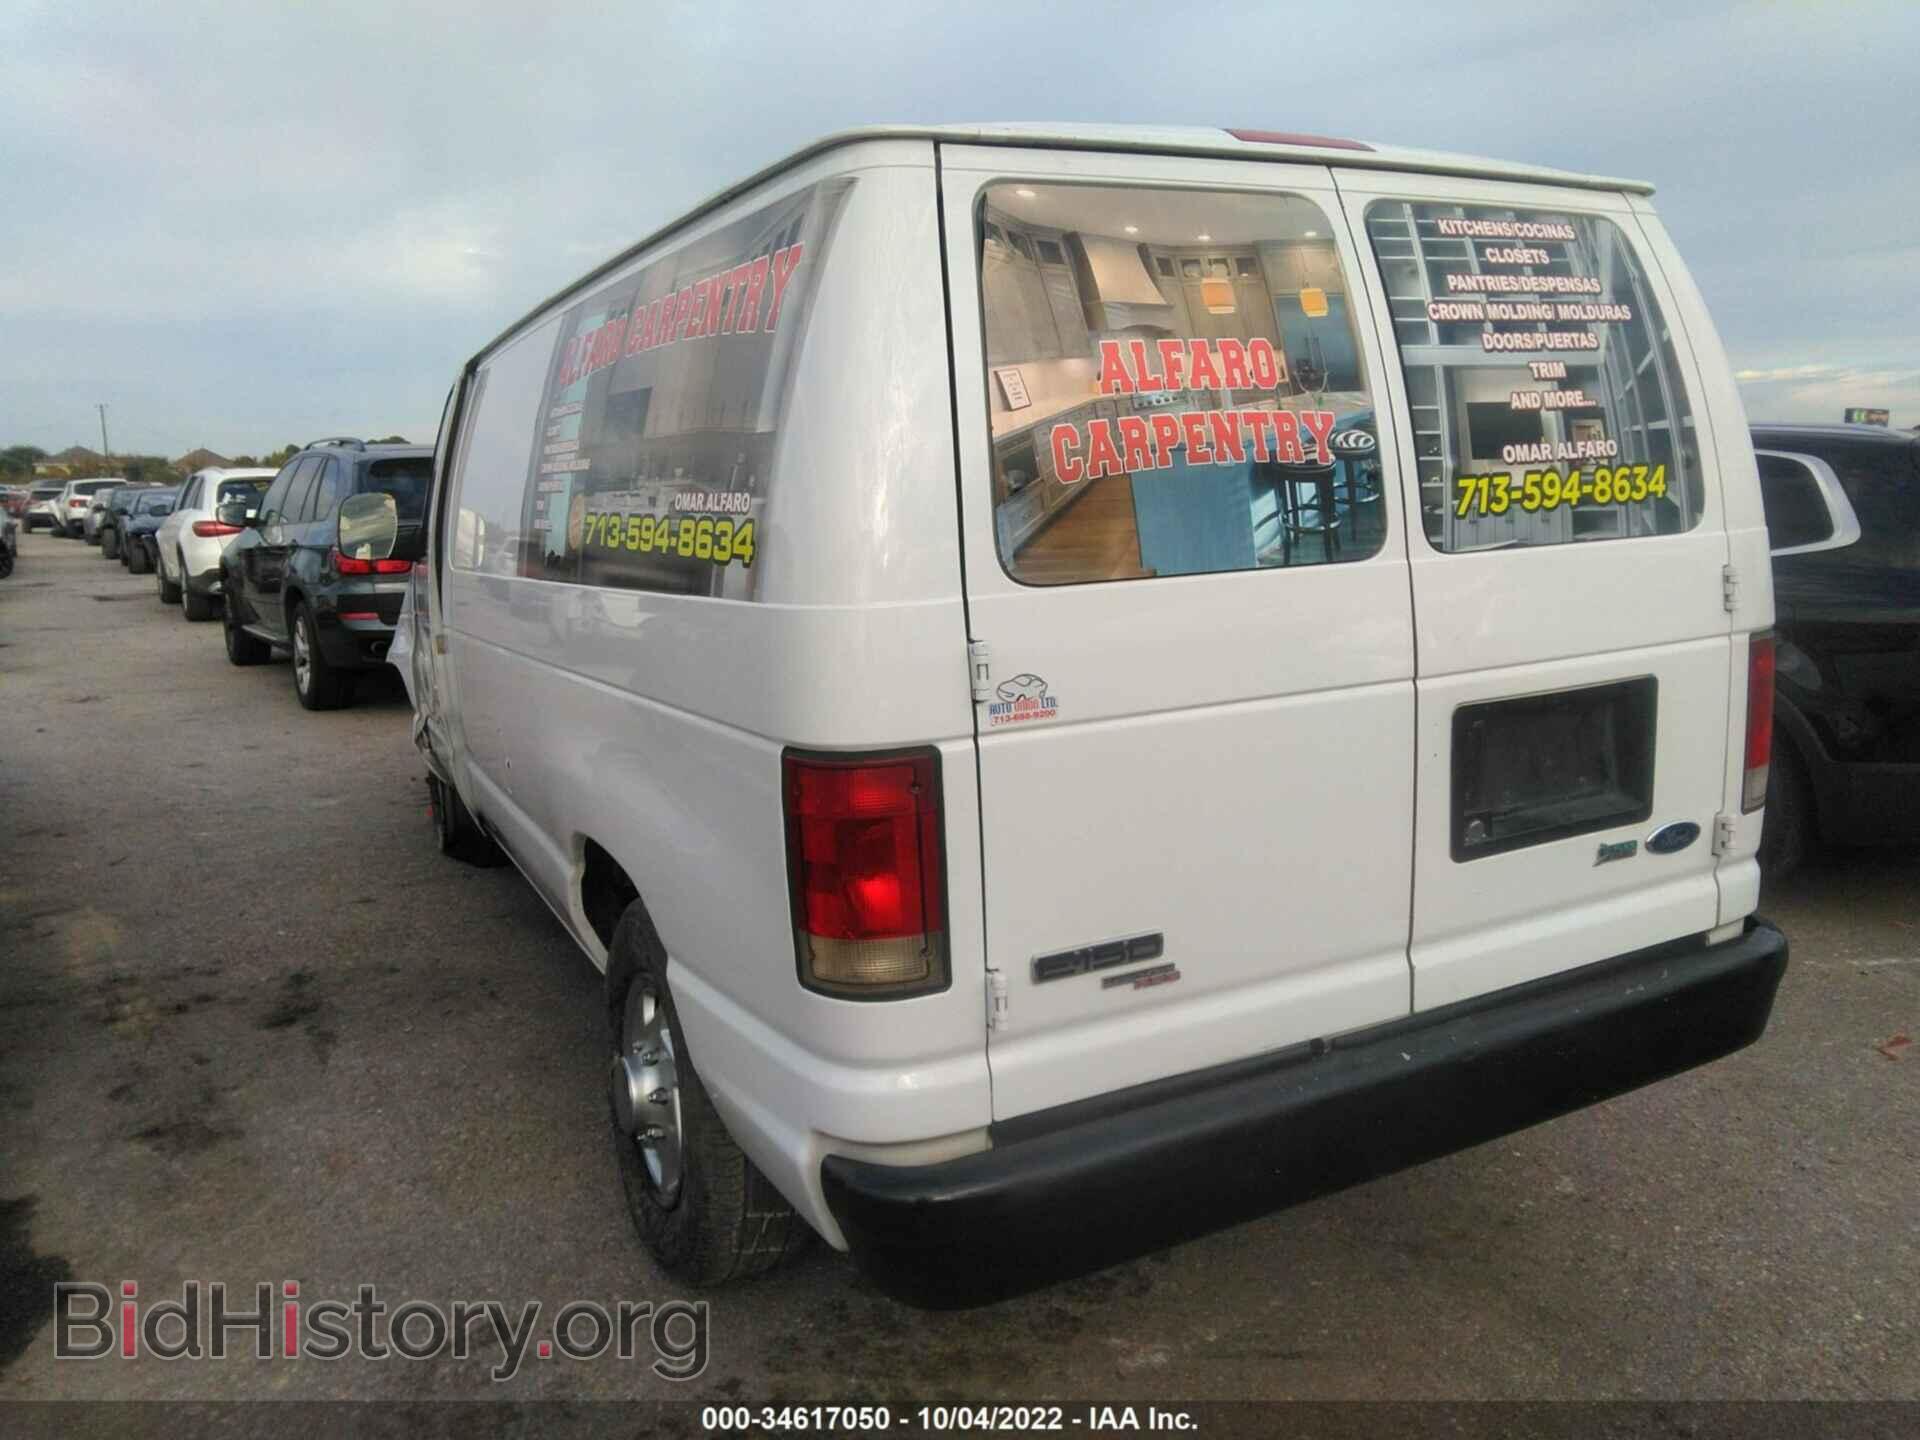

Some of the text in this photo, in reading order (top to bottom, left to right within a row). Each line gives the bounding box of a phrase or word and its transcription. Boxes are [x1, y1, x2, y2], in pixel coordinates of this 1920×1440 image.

[1485, 247, 1550, 265] CLOSETS
[1446, 275, 1601, 294] PANTRIES/DESPENSAS
[622, 241, 804, 360] CARPENTRY
[1427, 303, 1483, 321] CROWN
[1557, 304, 1631, 322] MOLDURAS
[1481, 333, 1598, 352] DOORS/PUERTAS
[1097, 338, 1281, 398] ALFARO
[1529, 361, 1566, 380] TRIM
[1510, 392, 1541, 410] AND
[1050, 411, 1337, 485] CARPENTRY
[1502, 440, 1618, 464] OMAR ALFARO
[1455, 464, 1667, 518] 713-594-8634
[675, 492, 751, 514] OMAR ALFARO
[583, 512, 756, 568] 713-594-8634
